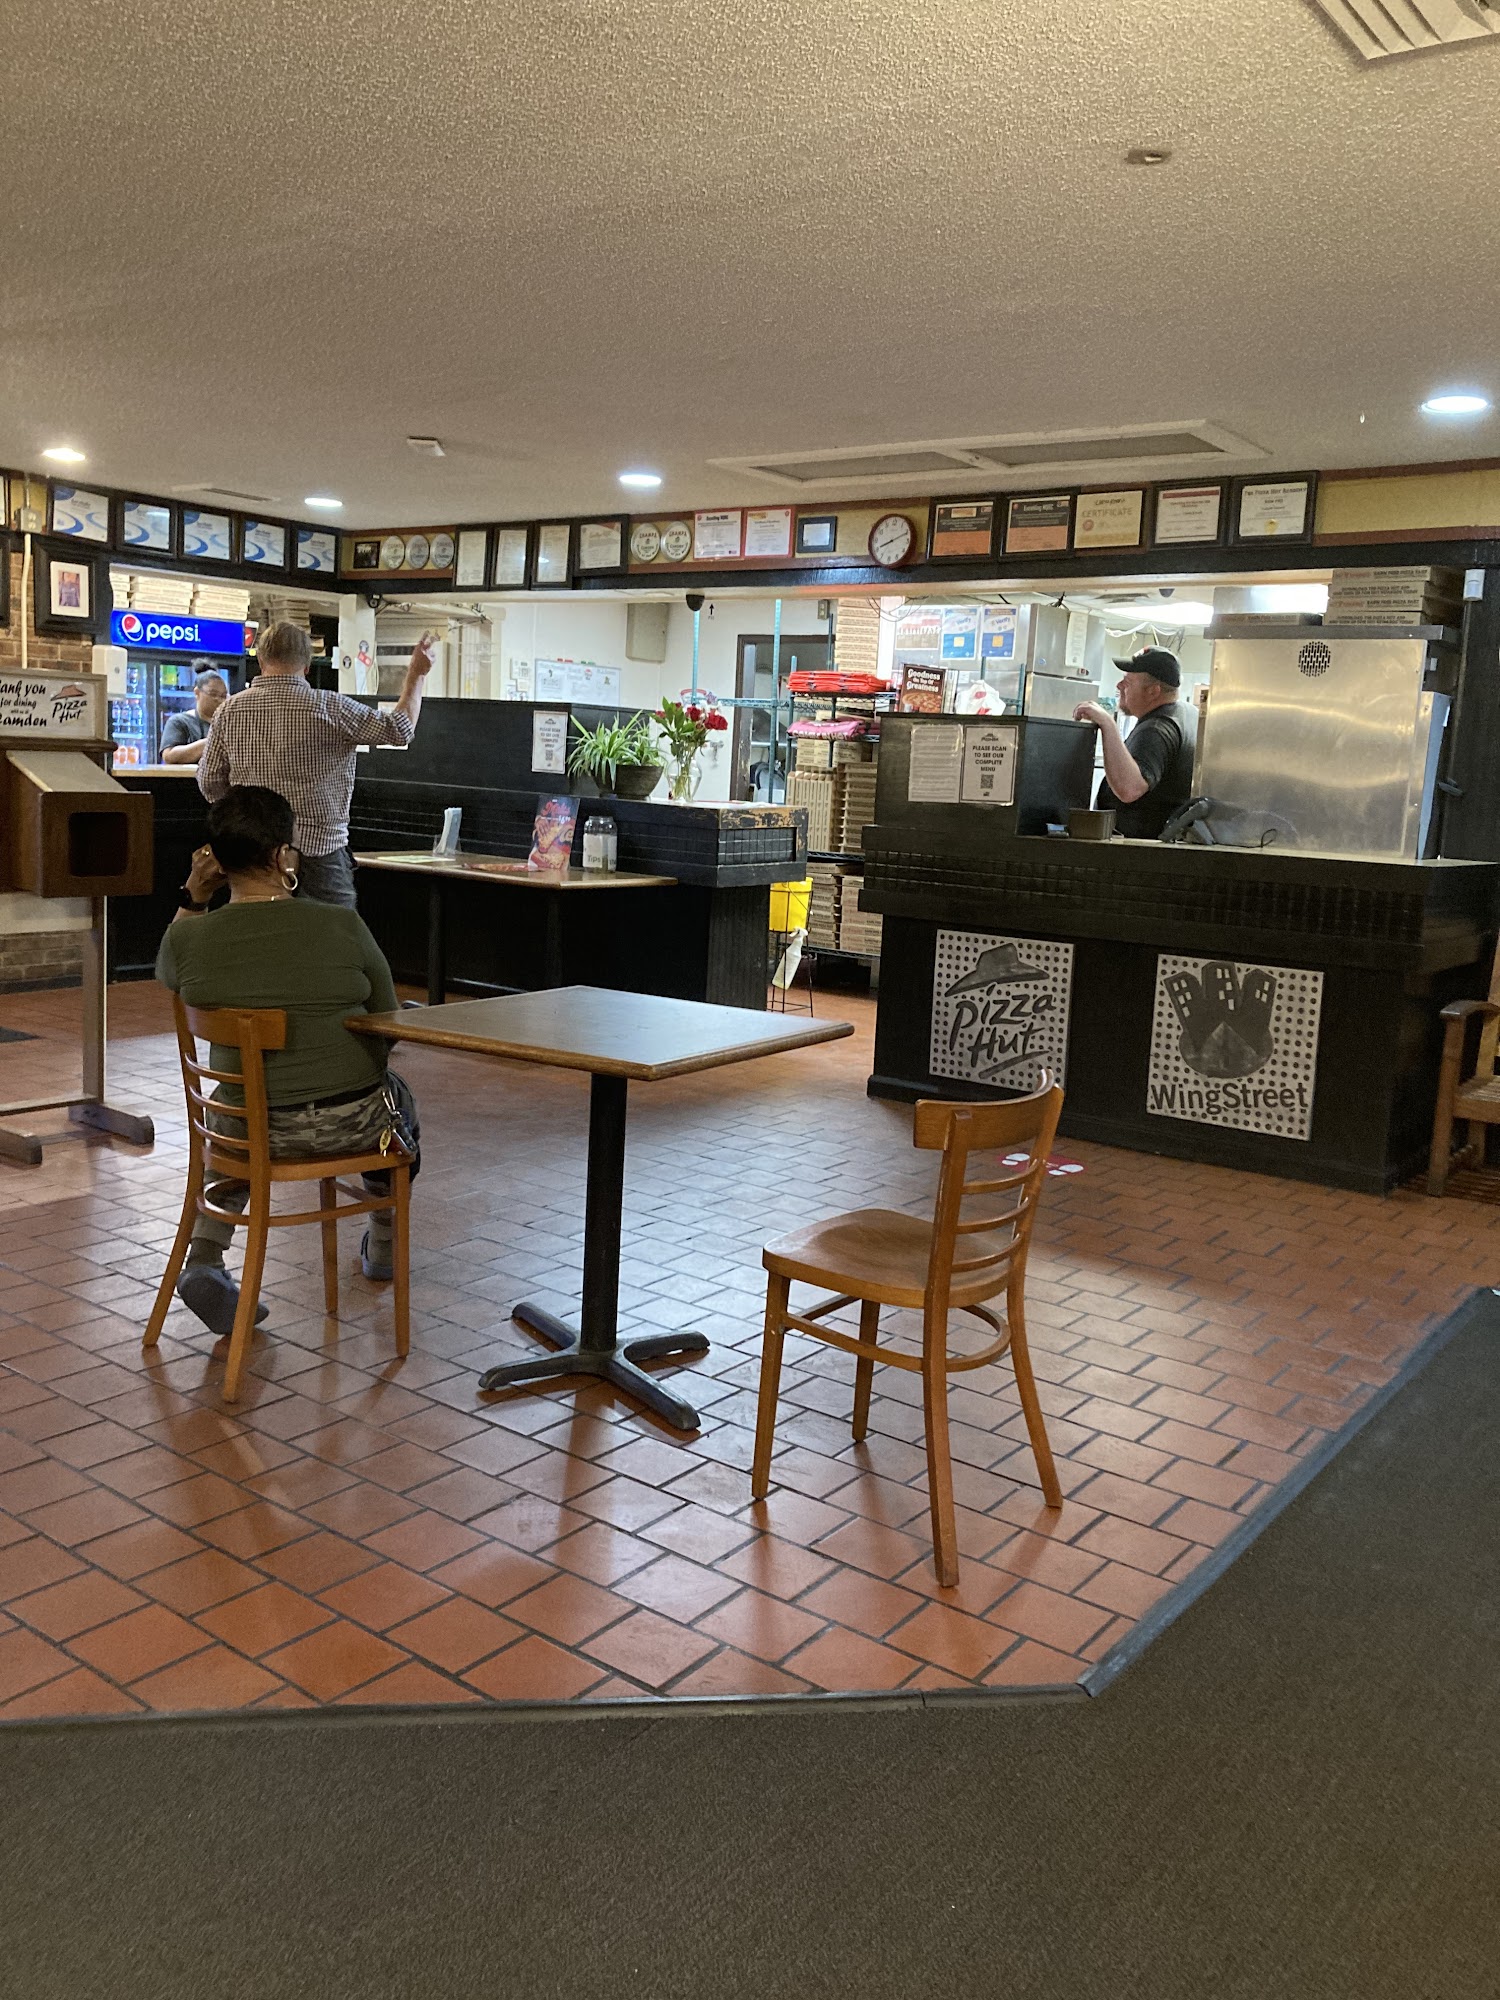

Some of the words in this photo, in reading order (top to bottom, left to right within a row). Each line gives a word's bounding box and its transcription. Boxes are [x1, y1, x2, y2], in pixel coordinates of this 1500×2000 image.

[147, 623, 198, 644] pepsi
[908, 669, 940, 680] Goodness
[0, 680, 22, 697] ank
[24, 684, 46, 697] you
[907, 681, 939, 692] Greatness
[0, 698, 11, 707] for
[14, 698, 36, 709] dining
[52, 698, 87, 718] Pizza
[60, 710, 83, 722] Hut
[588, 854, 601, 863] Tips
[950, 984, 1056, 1051] Pizza
[968, 1022, 1045, 1068] Hut
[1150, 1082, 1308, 1115] WingStreet
